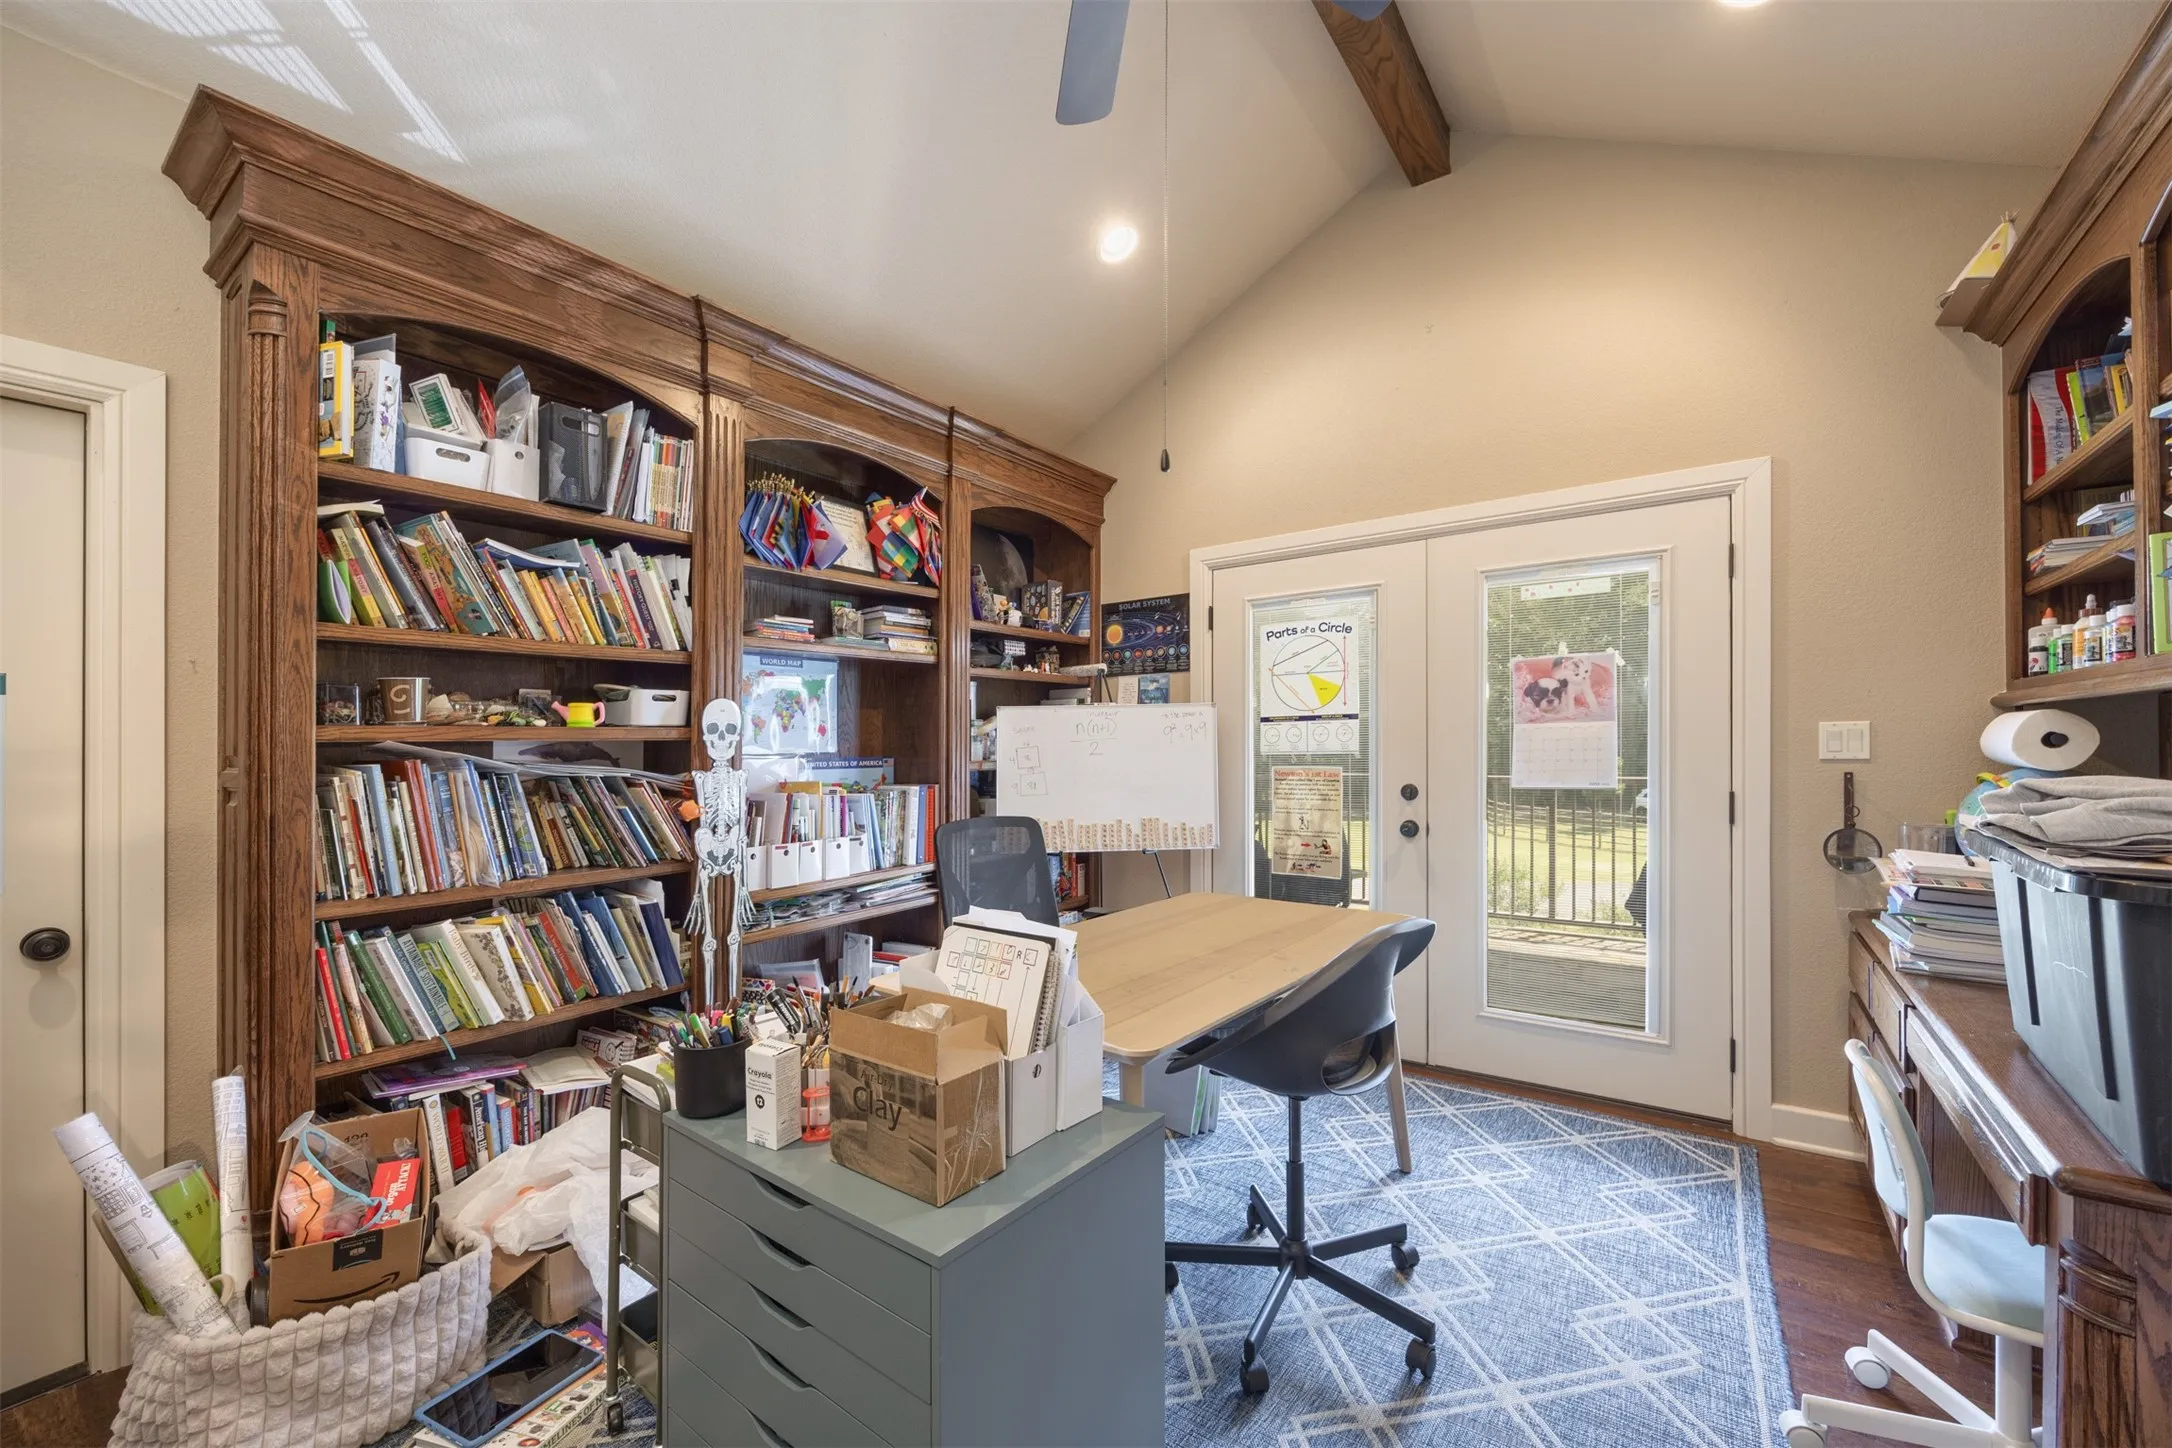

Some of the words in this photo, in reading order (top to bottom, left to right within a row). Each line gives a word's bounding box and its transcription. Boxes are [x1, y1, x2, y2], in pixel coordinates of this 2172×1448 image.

[632, 579, 644, 603] HISTORY
[640, 600, 651, 621] QUEST
[1119, 602, 1141, 611] SOLAR
[1143, 598, 1171, 608] SYSTEM
[1266, 626, 1298, 642] Parts
[1300, 626, 1309, 634] of
[1318, 622, 1353, 634] Circle
[762, 658, 786, 666] WORLD
[828, 760, 849, 768] STATES
[859, 759, 883, 767] AMERICA
[448, 929, 463, 950] Baby
[460, 948, 475, 974] Birds
[402, 939, 426, 973] ATTAINABLE
[420, 969, 447, 1011] SUSTAINABLE
[747, 1067, 772, 1079] Crayola
[861, 1069, 893, 1091] Air-Dry
[756, 1096, 764, 1107] 12
[853, 1086, 902, 1132] Clay
[432, 1111, 446, 1141] WORLD
[474, 1105, 486, 1140] American
[396, 1162, 412, 1192] ATTACK!
[541, 1414, 583, 1448] MELINES
[583, 1405, 595, 1416] OF
